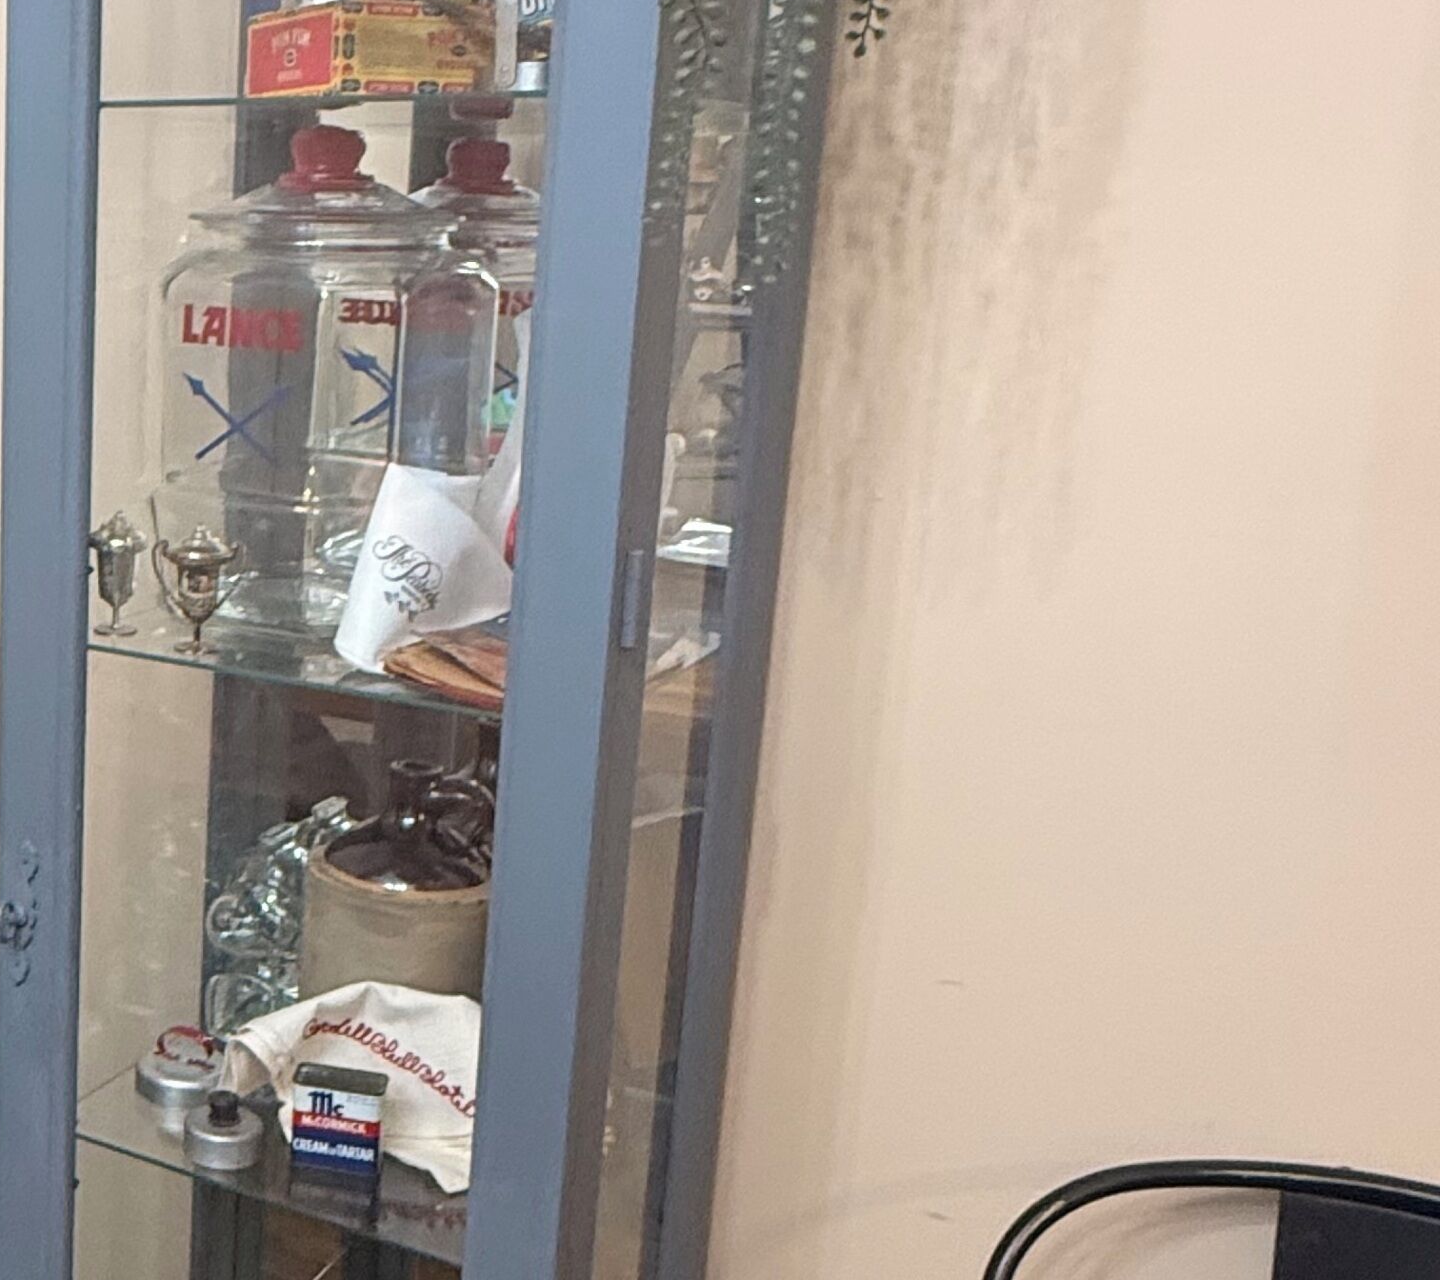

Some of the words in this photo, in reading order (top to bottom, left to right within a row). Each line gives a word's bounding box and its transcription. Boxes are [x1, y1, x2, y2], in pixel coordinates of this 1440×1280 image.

[183, 304, 303, 352] LANCE
[292, 1137, 330, 1156] CREAM
[335, 1143, 375, 1162] TARTAR
